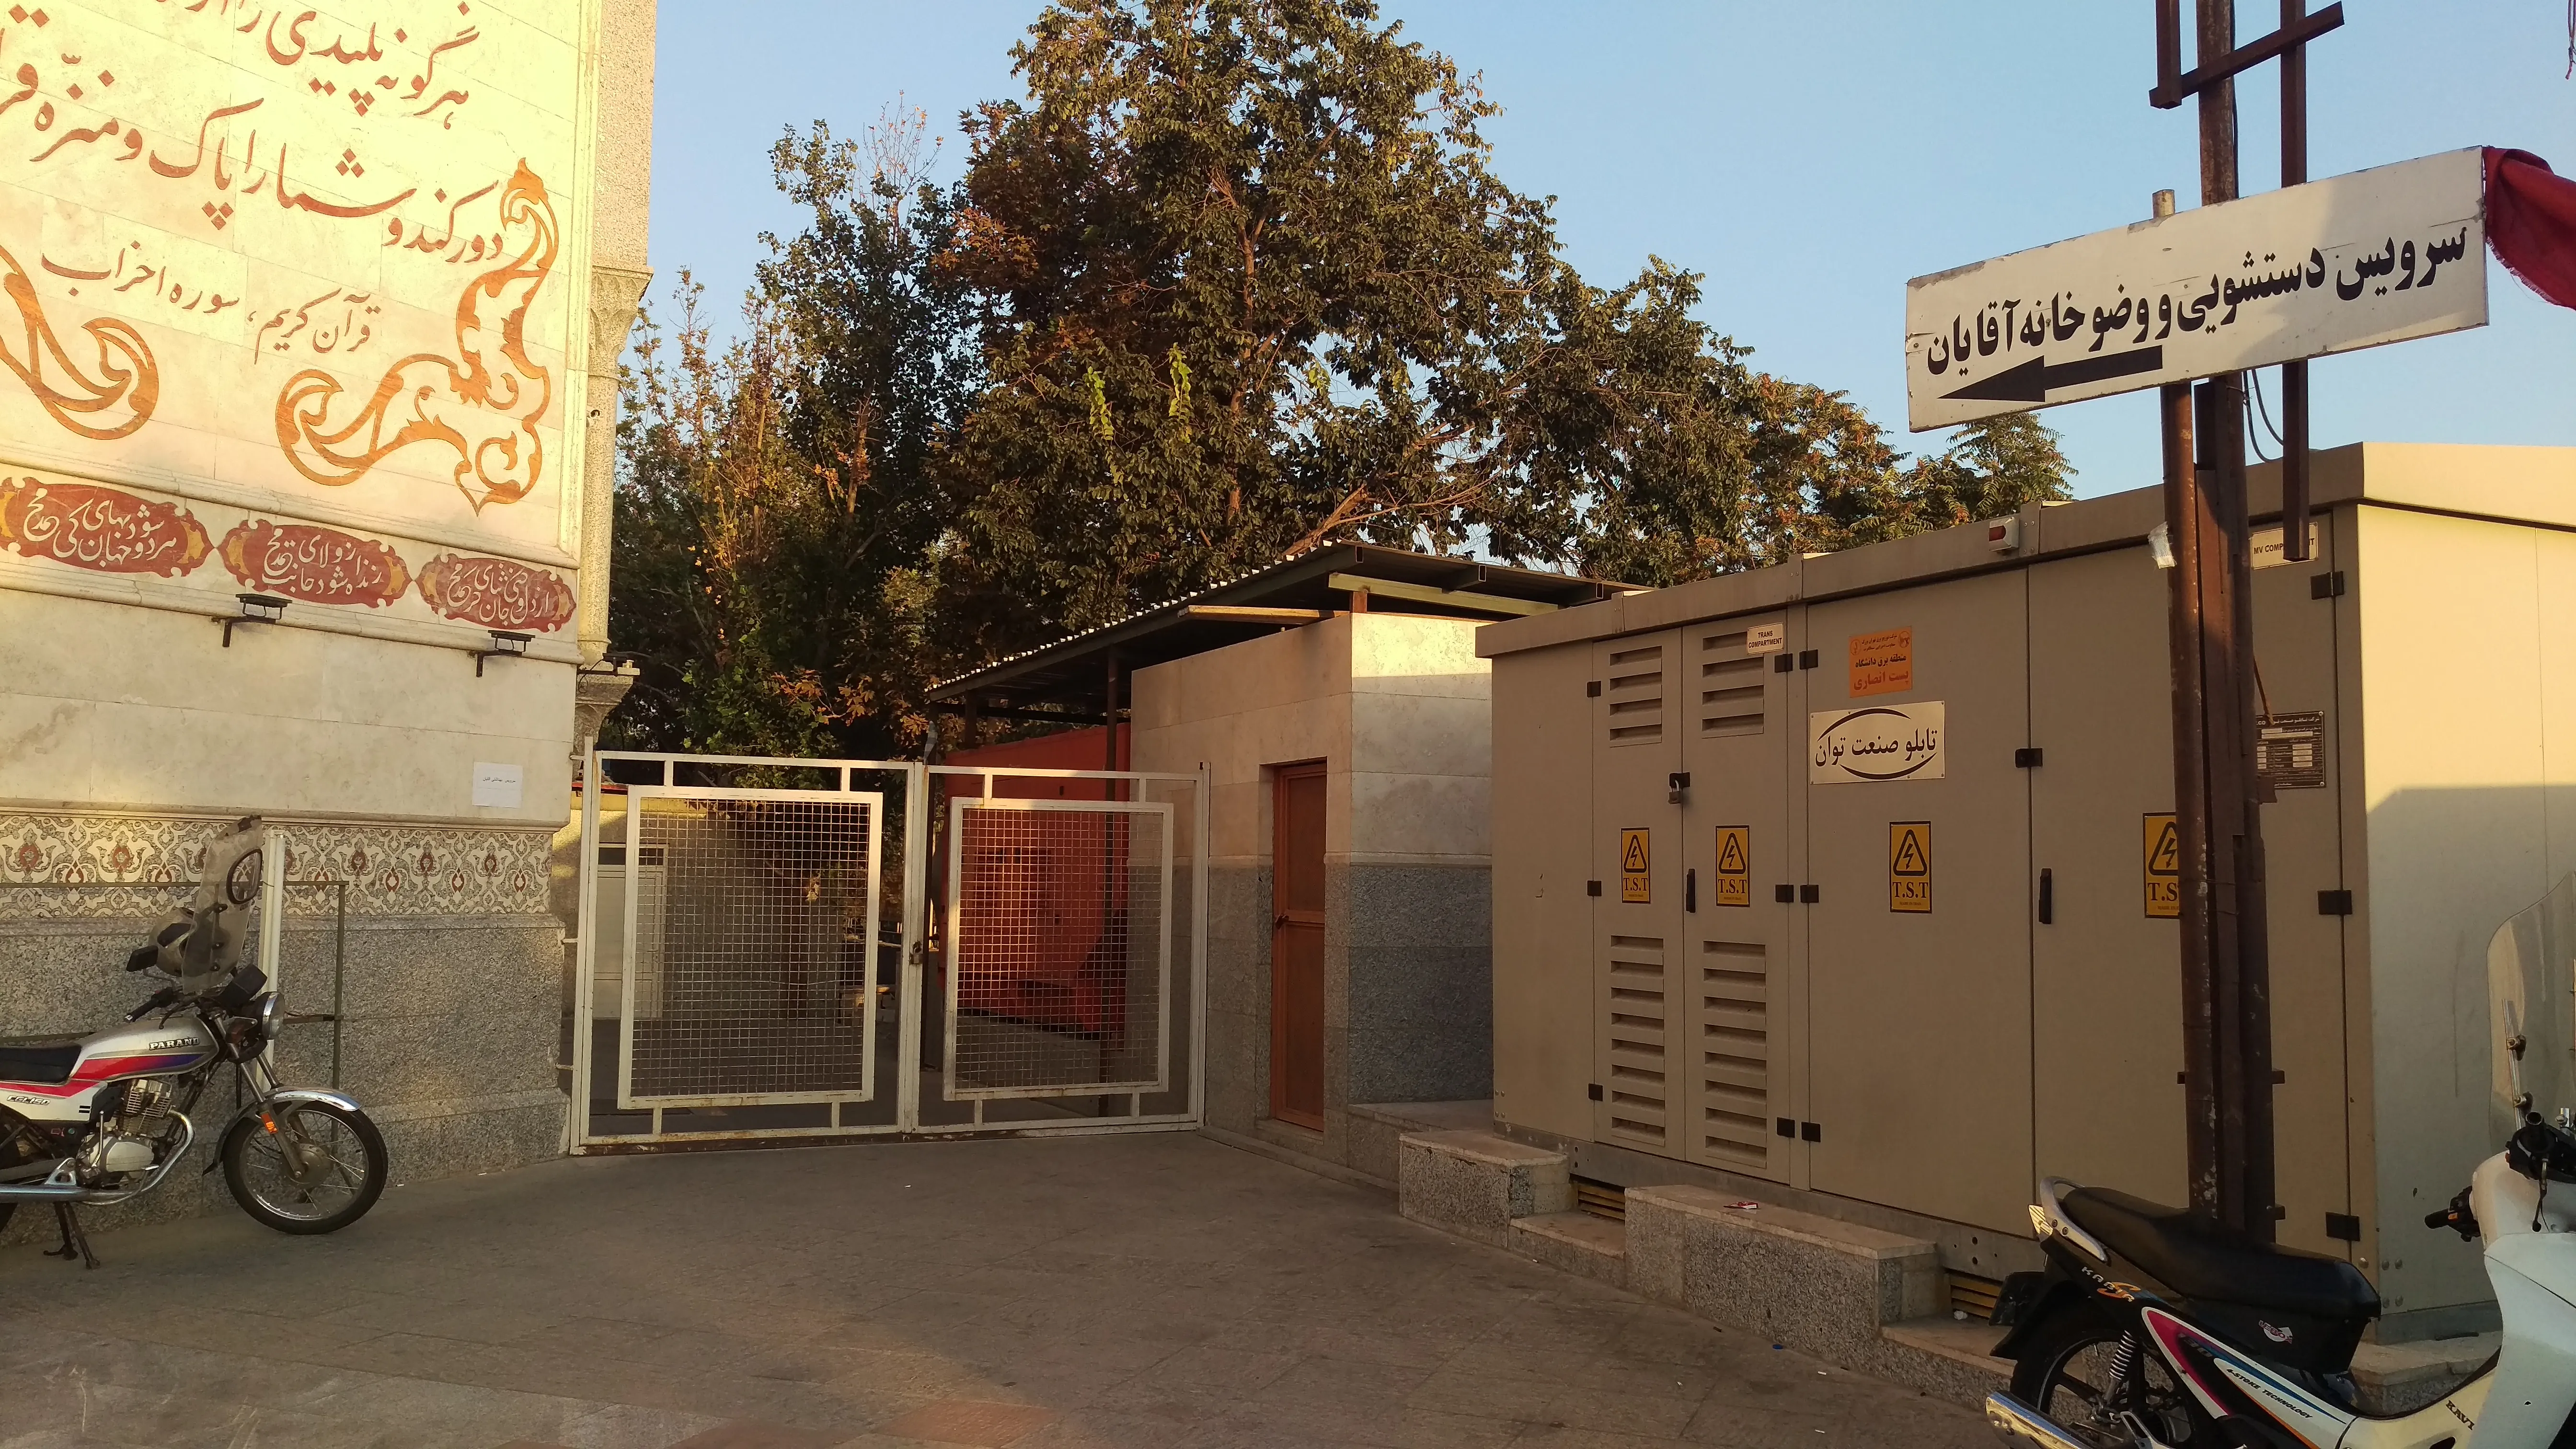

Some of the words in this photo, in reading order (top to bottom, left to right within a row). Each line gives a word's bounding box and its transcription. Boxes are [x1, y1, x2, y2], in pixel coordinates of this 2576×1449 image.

[266, 11, 383, 116] پلیدی
[115, 128, 143, 161] و
[149, 97, 264, 230] پاک
[241, 129, 266, 194] را
[276, 142, 417, 218] شما
[382, 217, 403, 247] و
[403, 180, 498, 253] کند
[446, 232, 503, 263] دور
[2335, 226, 2467, 301] سرویس
[41, 240, 166, 296] احزاب
[169, 284, 240, 313] سوره
[2177, 247, 2325, 334] دستشویی
[313, 293, 382, 354] قرآن
[2155, 294, 2172, 340] و
[1927, 298, 2021, 377] آقایان
[23, 488, 60, 541] محمد
[264, 528, 293, 576] محمد
[2254, 546, 2263, 554] MV
[447, 563, 472, 608] محمد
[1748, 637, 1782, 648] COMPARTMENT
[1890, 654, 1907, 663] منطقه
[1855, 657, 1876, 667] دانشگاه
[1878, 657, 1888, 667] برق
[1889, 671, 1909, 685] پست
[1854, 671, 1886, 690] انصاری
[1815, 735, 1846, 767] توان
[1852, 735, 1898, 756] صنعت
[1904, 727, 1938, 761] تابلو
[1623, 877, 1648, 891] T.S.T
[1717, 879, 1748, 894] T.S.T
[1892, 882, 1929, 898] T.S.T
[149, 1037, 200, 1050] PARAND
[2262, 1389, 2313, 1419] TECHNOLOGY
